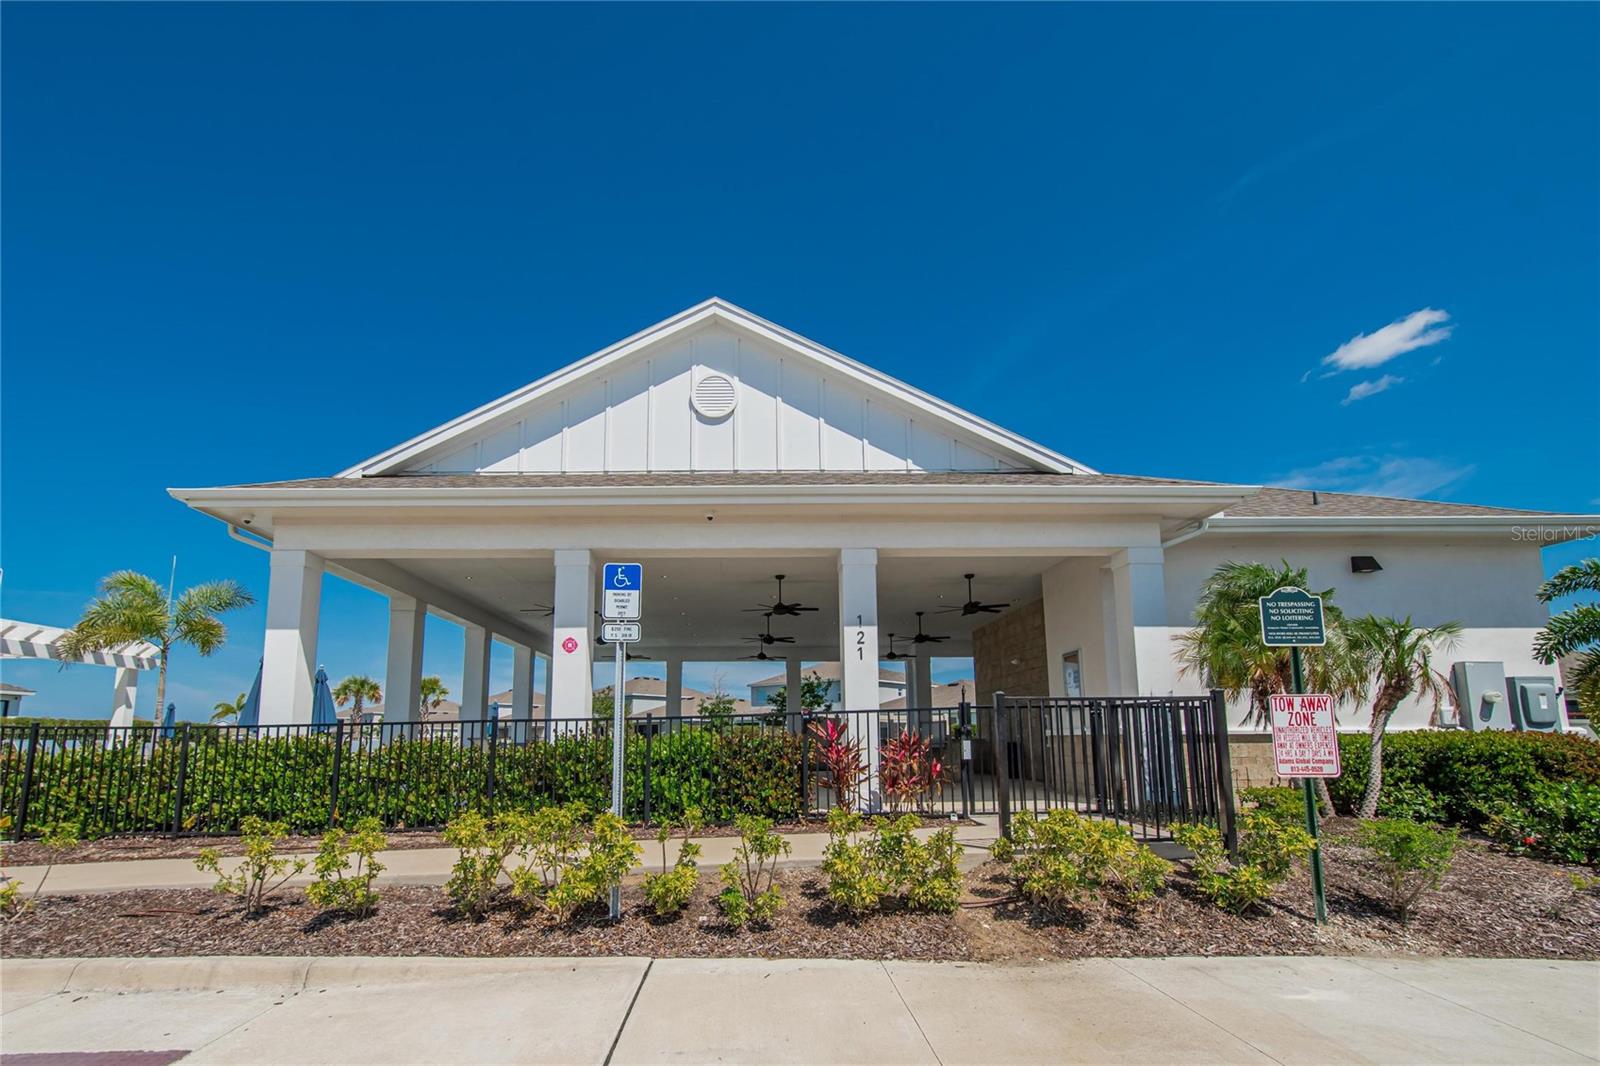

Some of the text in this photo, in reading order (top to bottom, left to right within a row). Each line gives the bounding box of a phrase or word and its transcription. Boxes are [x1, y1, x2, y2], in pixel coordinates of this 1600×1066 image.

[1273, 697, 1329, 712] TOW AWAY
[1288, 712, 1317, 726] ZONE
